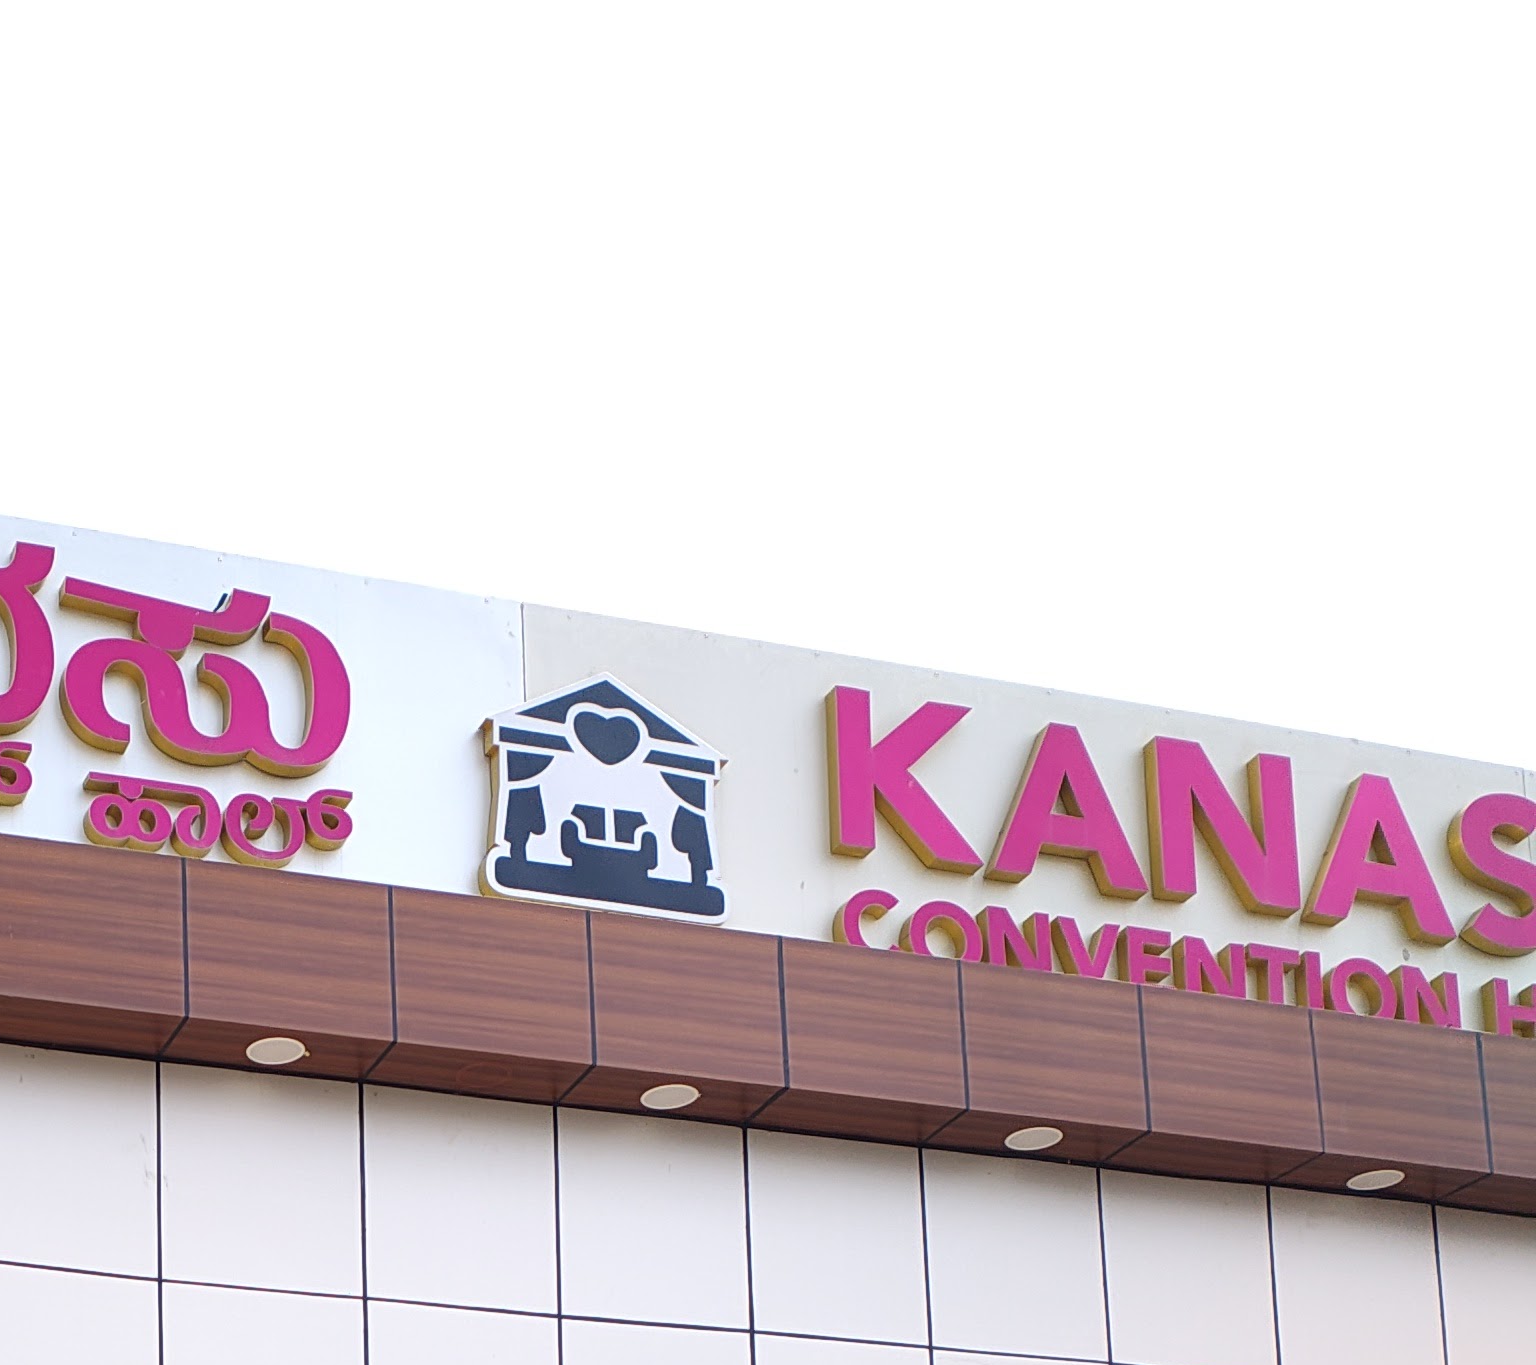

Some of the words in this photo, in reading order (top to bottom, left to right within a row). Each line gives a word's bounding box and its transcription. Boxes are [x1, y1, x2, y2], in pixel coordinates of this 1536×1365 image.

[83, 771, 354, 868] ಹಾಲ್
[825, 685, 1536, 957] KANAS
[832, 888, 1462, 1031] CONVENTION
